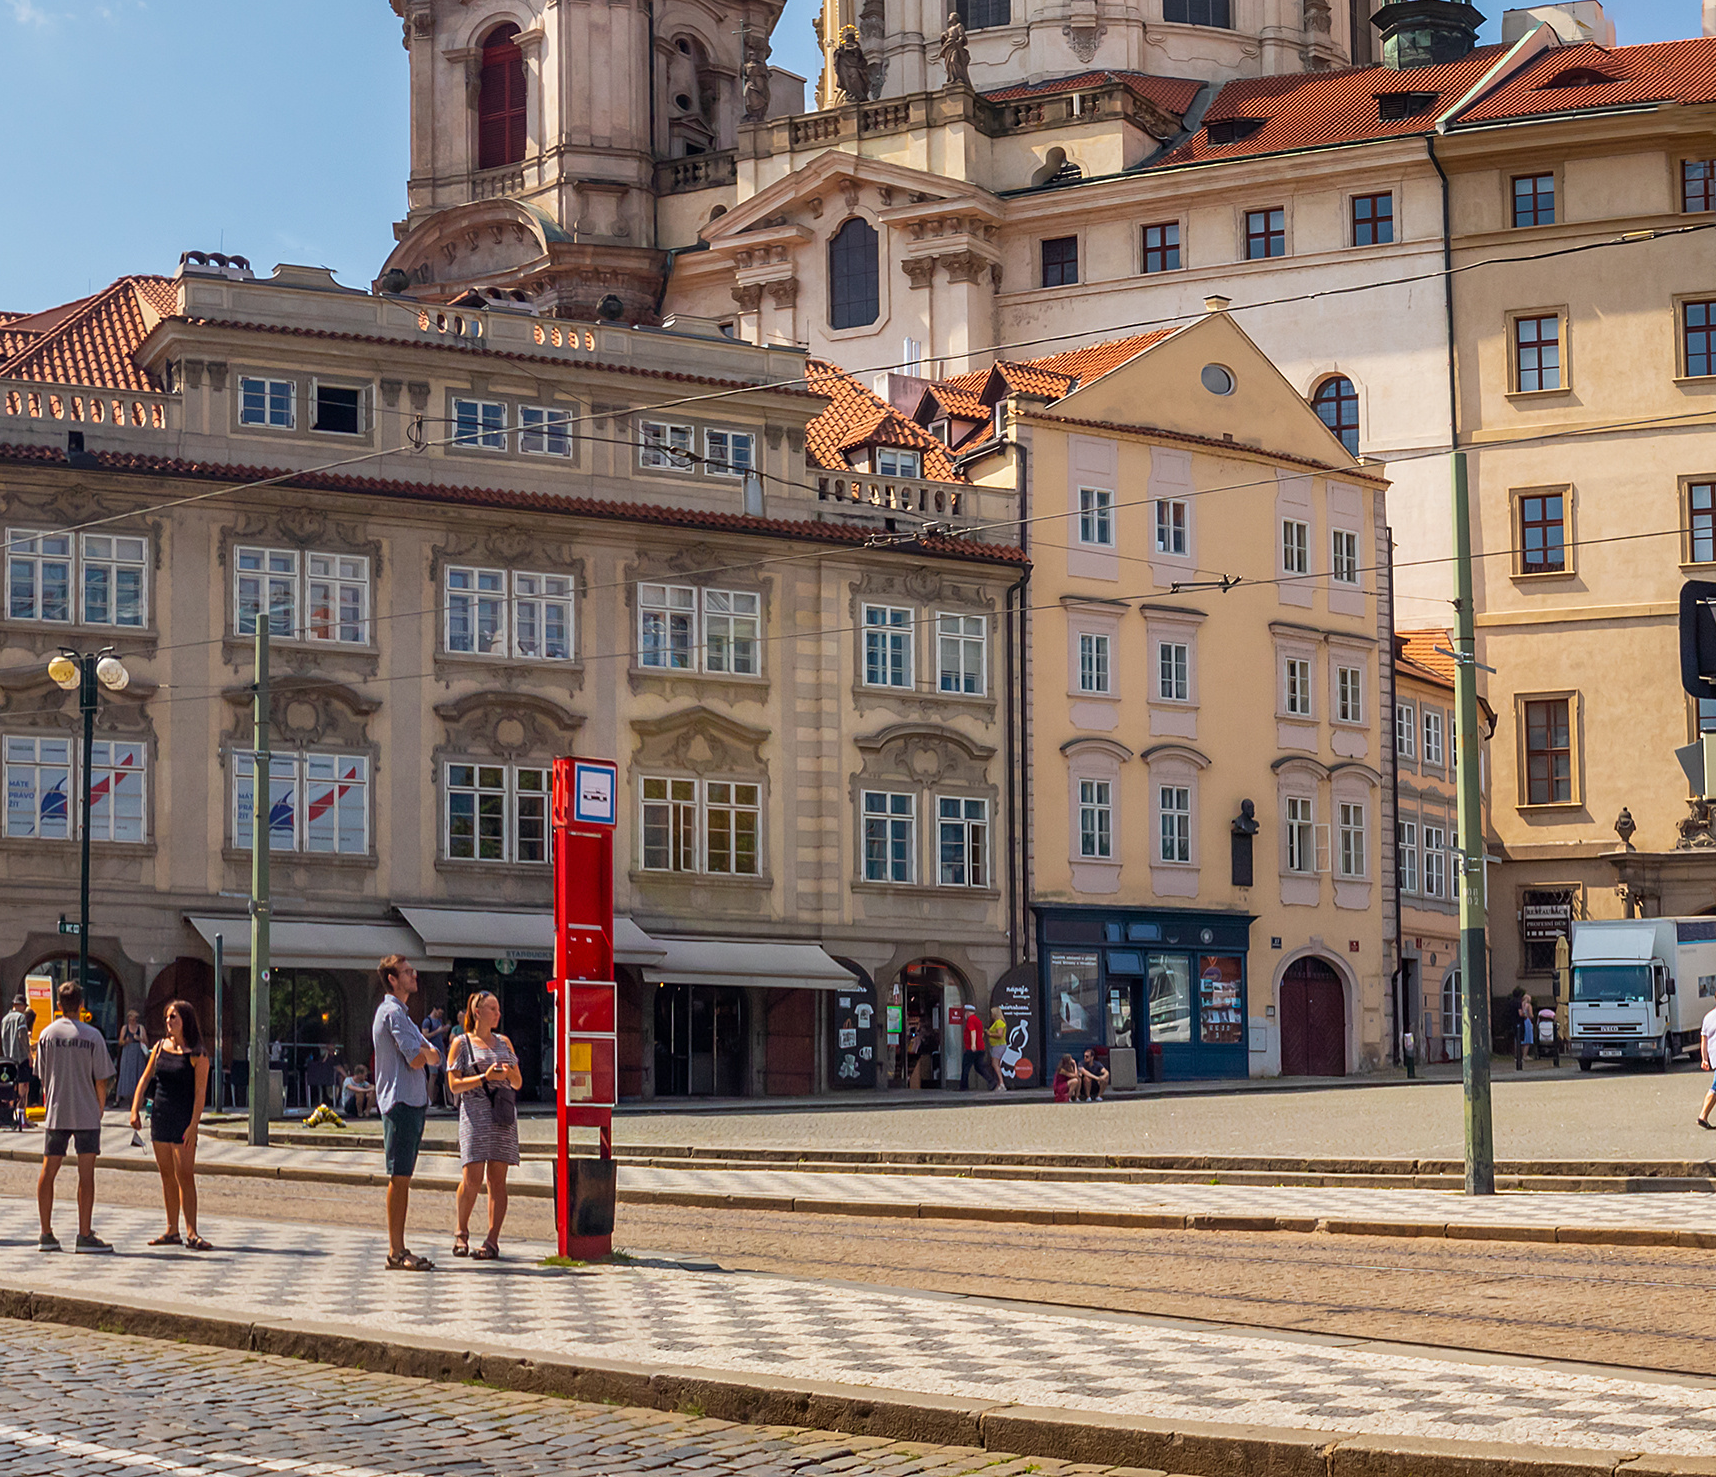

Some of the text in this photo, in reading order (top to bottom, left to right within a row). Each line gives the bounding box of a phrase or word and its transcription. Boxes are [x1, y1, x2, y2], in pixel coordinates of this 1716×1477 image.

[9, 780, 29, 788] MÁTE
[9, 791, 35, 799] PRÁVO
[9, 800, 19, 808] ŽÍT
[506, 950, 553, 960] STARBUCKS
